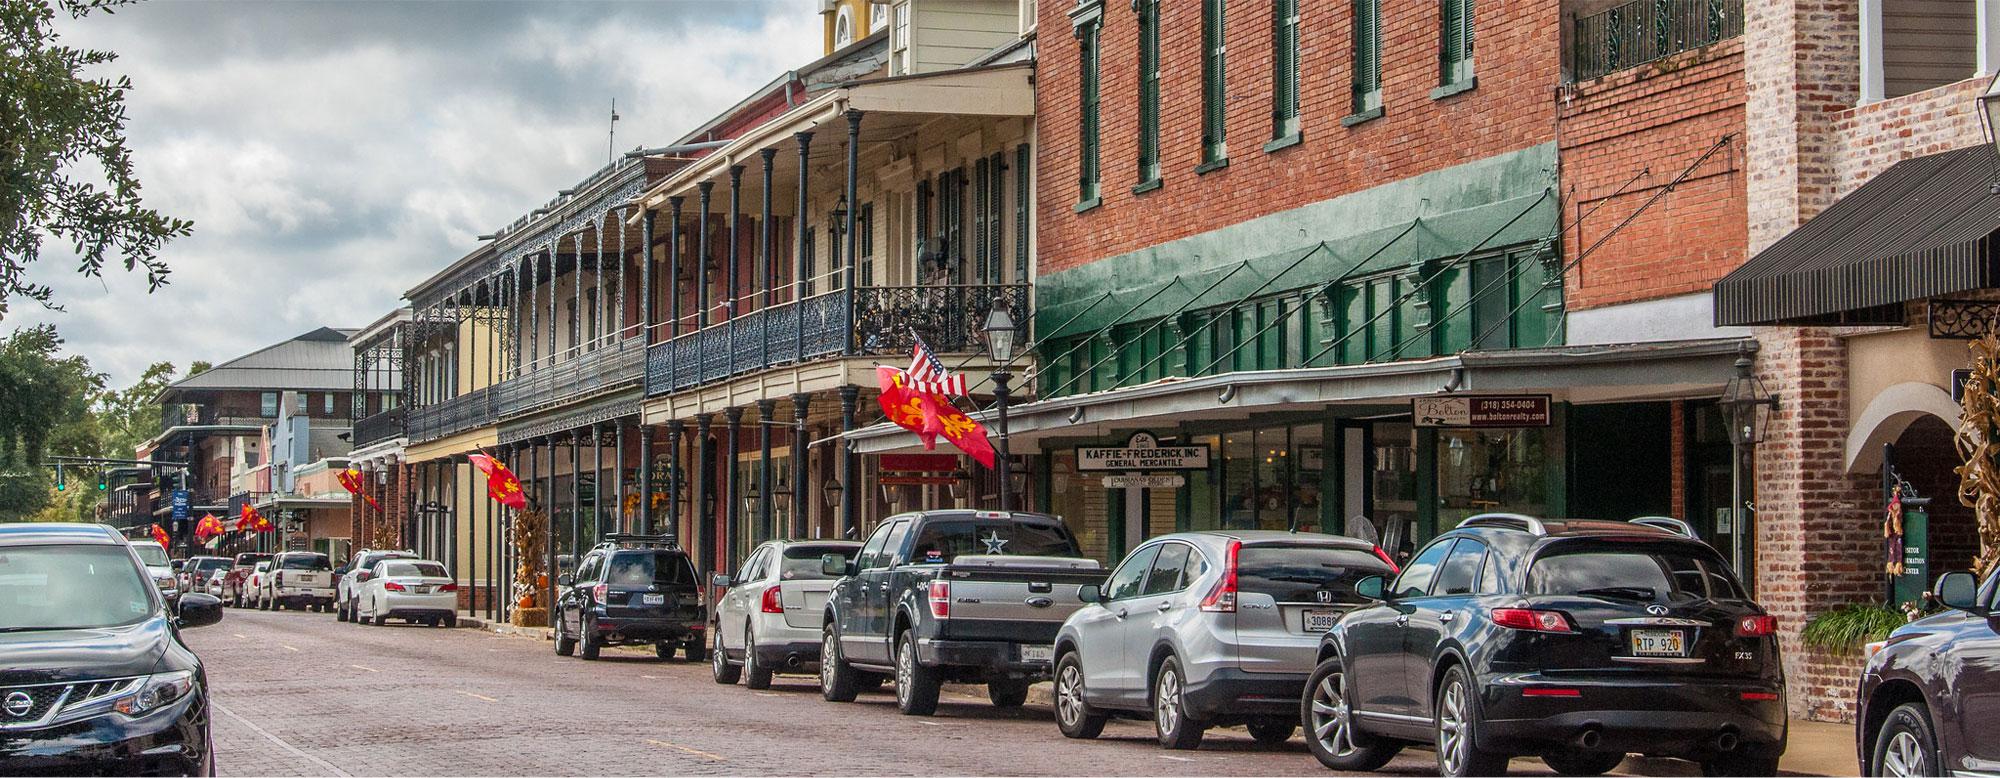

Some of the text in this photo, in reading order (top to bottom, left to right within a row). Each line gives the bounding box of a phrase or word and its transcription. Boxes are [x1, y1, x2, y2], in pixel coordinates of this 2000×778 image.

[1427, 402, 1467, 416] Bolton
[1481, 400, 1535, 410] (318) 354-0404
[1471, 411, 1545, 422] www.boltonrealty.com
[1105, 458, 1183, 468] GENERAL MERCANTILE
[1636, 638, 1679, 651] RTP 920
